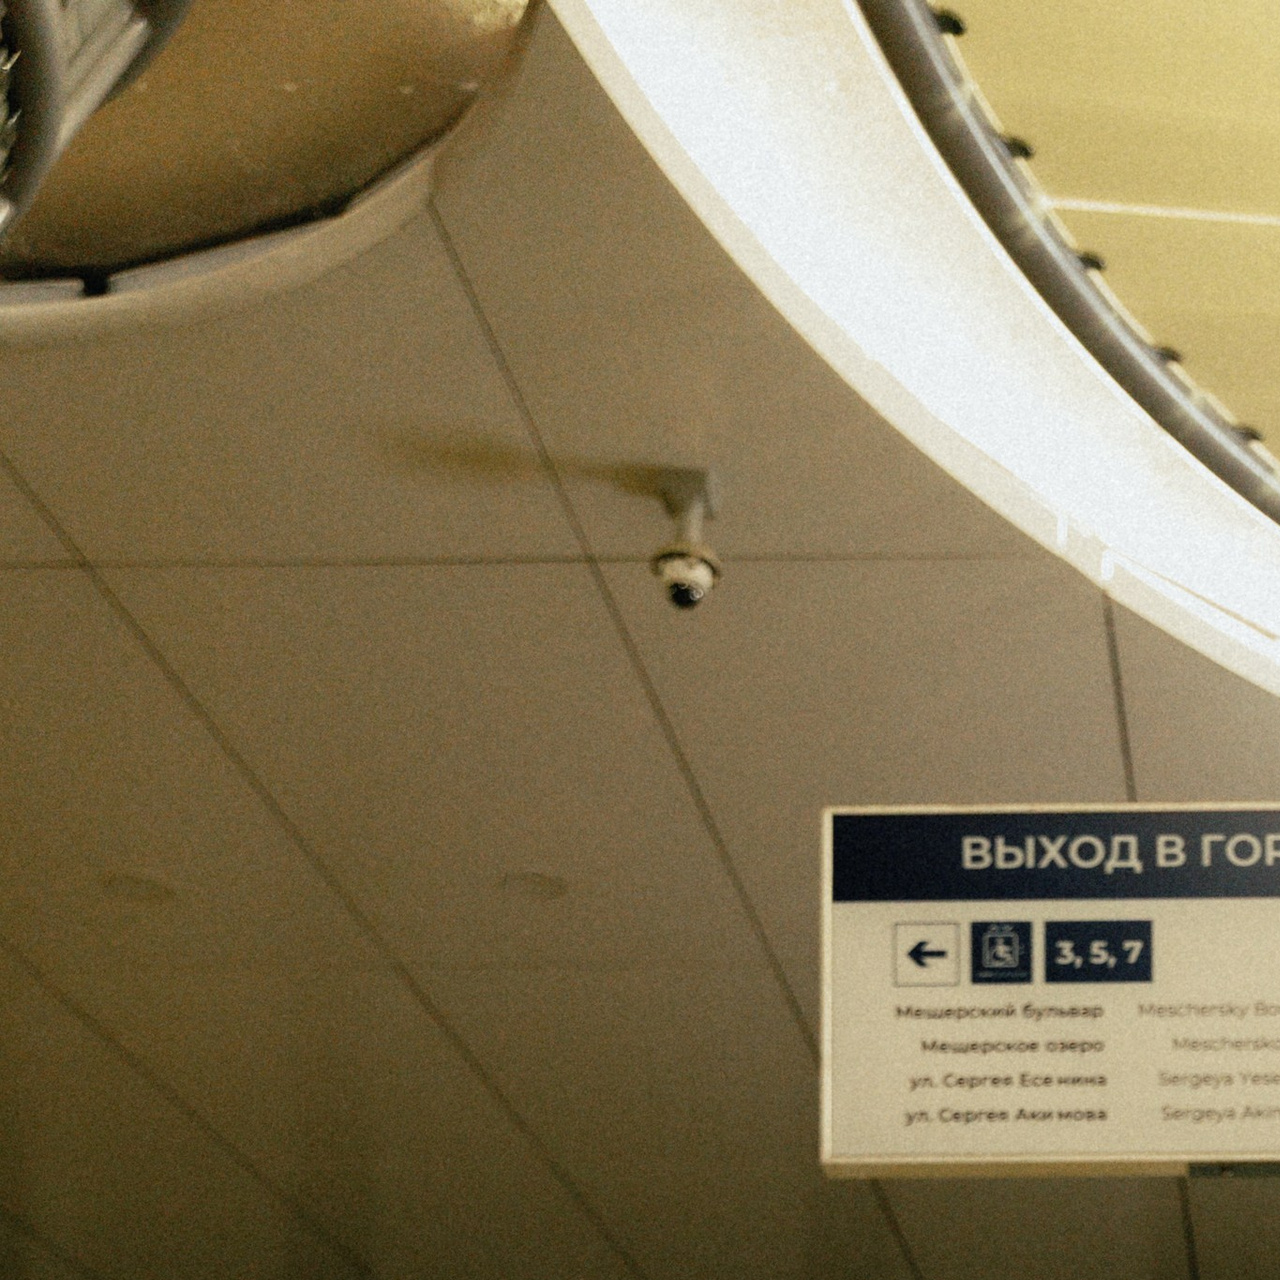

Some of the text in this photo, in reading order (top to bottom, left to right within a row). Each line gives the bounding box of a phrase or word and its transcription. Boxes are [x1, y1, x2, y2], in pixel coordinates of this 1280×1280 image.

[961, 834, 1143, 875] ВЫХОД
[1155, 834, 1187, 868] В
[896, 1002, 1104, 1021] Мещерский бульвар
[1138, 1002, 1248, 1020] Meschersky
[921, 1040, 1105, 1055] Мещерское озеро
[1158, 1070, 1234, 1089] Sergeya
[1161, 1105, 1237, 1124] Sergeya
